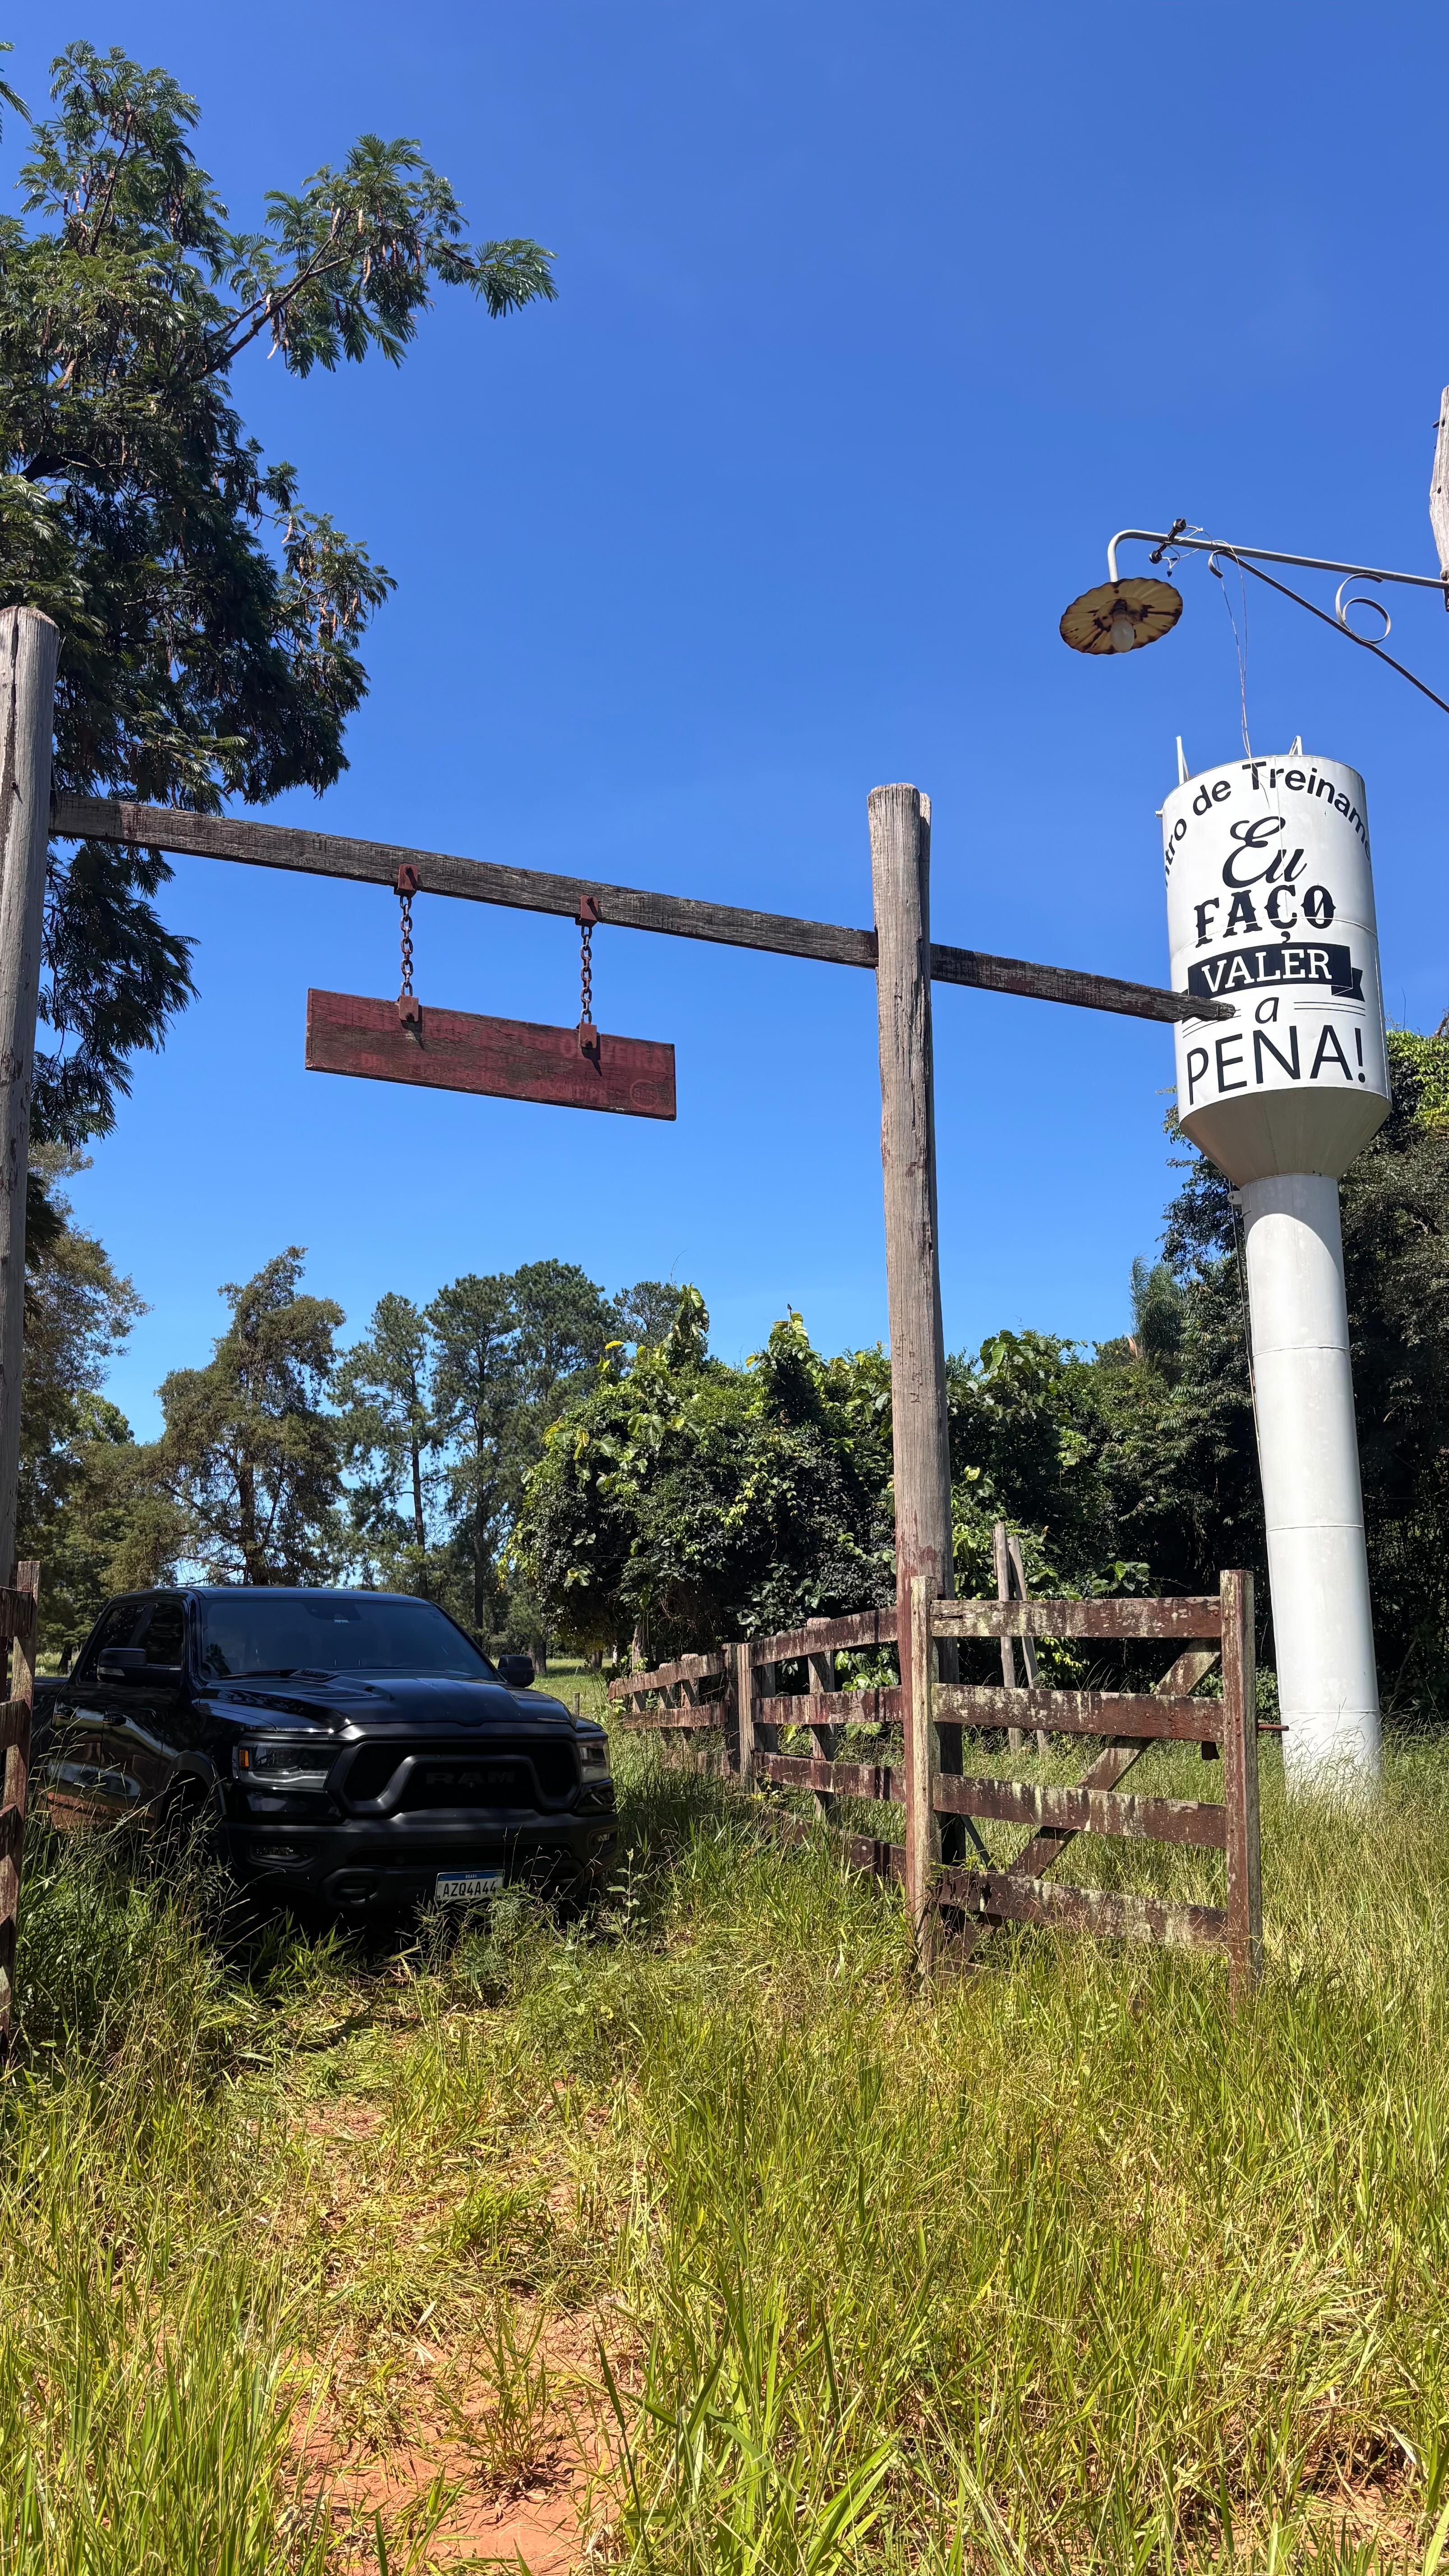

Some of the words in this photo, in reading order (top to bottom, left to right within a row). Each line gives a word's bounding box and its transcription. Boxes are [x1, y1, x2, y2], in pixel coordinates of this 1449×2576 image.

[1193, 781, 1232, 816] de
[1242, 761, 1371, 870] Treiname
[1222, 816, 1307, 888] Eu
[1194, 885, 1336, 948] FAÇO
[1201, 949, 1332, 993] VALER
[1255, 997, 1279, 1024] a
[1187, 1025, 1366, 1105] PENA!
[426, 1771, 515, 1784] RAM
[443, 1881, 496, 1897] AZQ4A44
